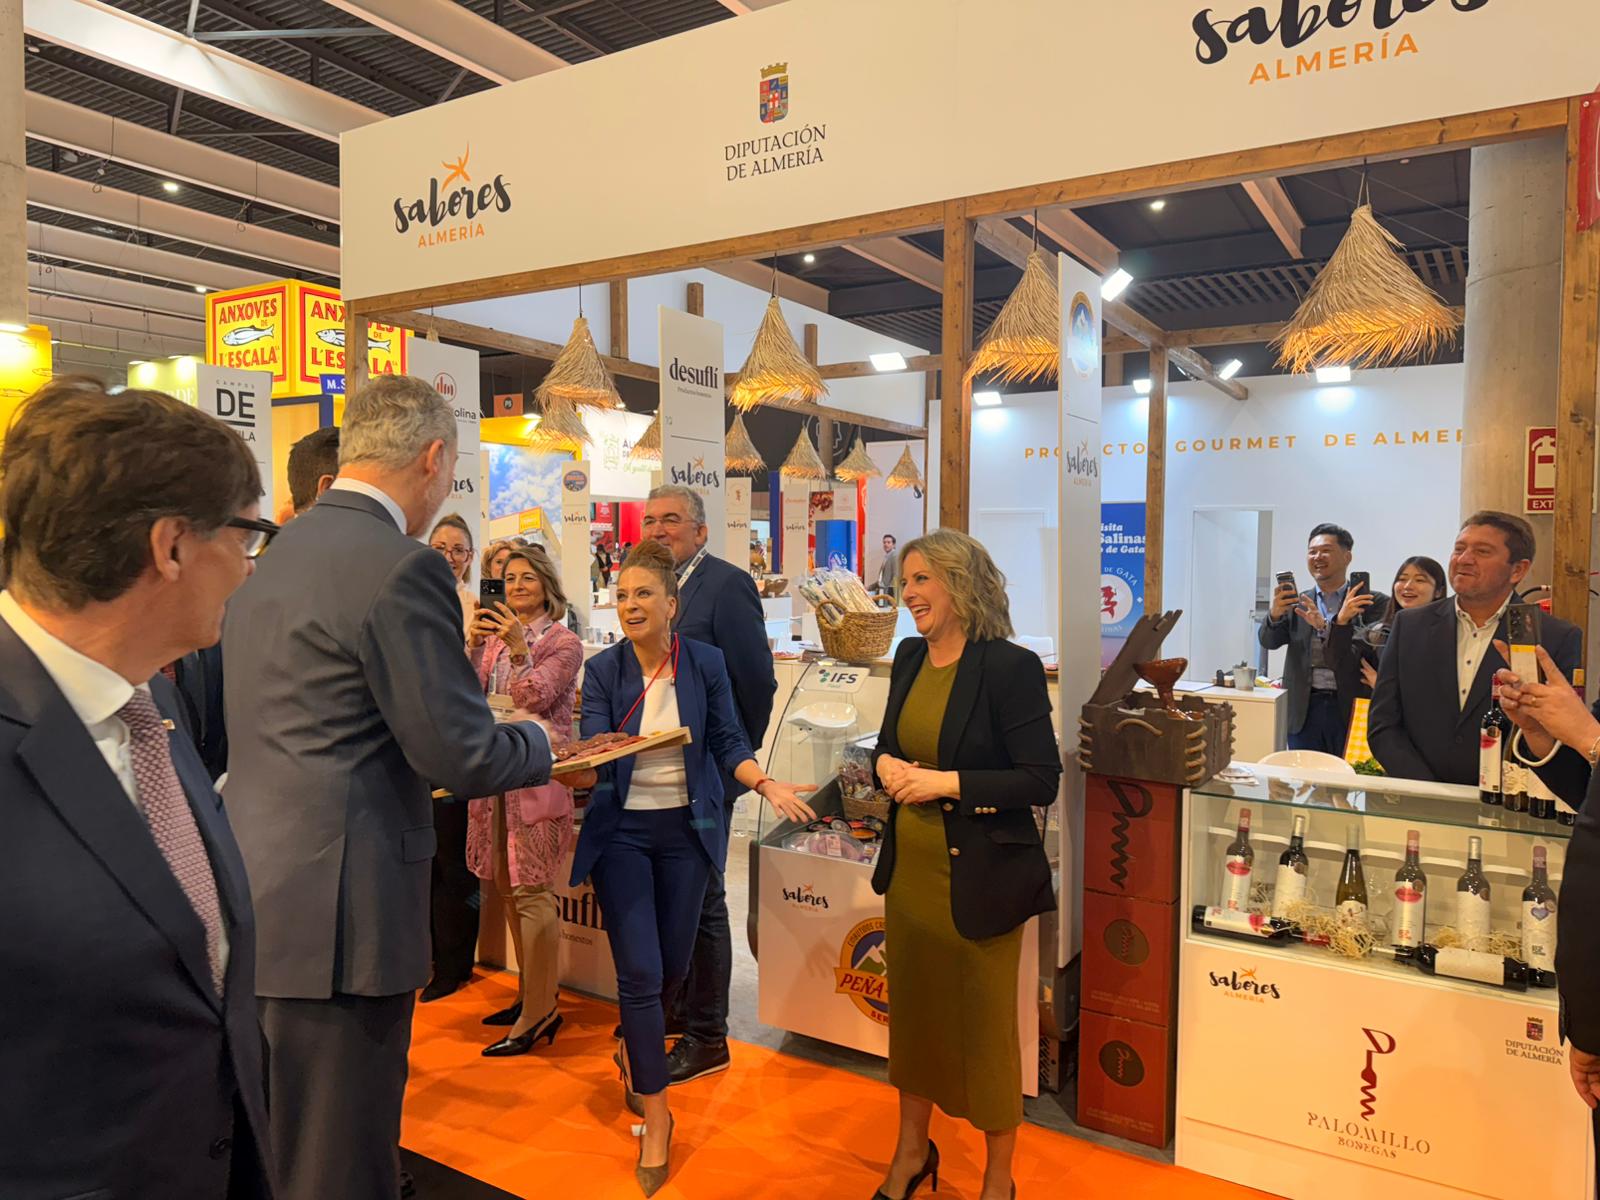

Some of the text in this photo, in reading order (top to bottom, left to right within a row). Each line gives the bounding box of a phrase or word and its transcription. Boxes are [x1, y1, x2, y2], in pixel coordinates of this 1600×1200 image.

[1192, 0, 1489, 64] sabor
[1249, 32, 1419, 84] ALMERÍA
[725, 123, 826, 161] DIPUTACIÓN
[726, 145, 824, 181] DE ALMERÍA
[393, 174, 511, 233] sabores
[418, 221, 485, 248] ALMERÍA
[219, 298, 277, 324] ANXOVES
[669, 357, 719, 389] desuflí
[216, 388, 256, 419] DE
[1175, 435, 1297, 453] GOURMET
[1324, 433, 1357, 447] DE
[671, 462, 720, 488] sabores
[1105, 545, 1119, 554] de
[830, 672, 859, 684] IFS
[782, 887, 829, 909] sabores
[840, 973, 885, 999] PEÑA
[1209, 970, 1280, 999] sabores
[1505, 1039, 1564, 1057] DIPUTACIÓN
[1506, 1047, 1519, 1056] DE
[1307, 1111, 1431, 1154] PALOMILLO
